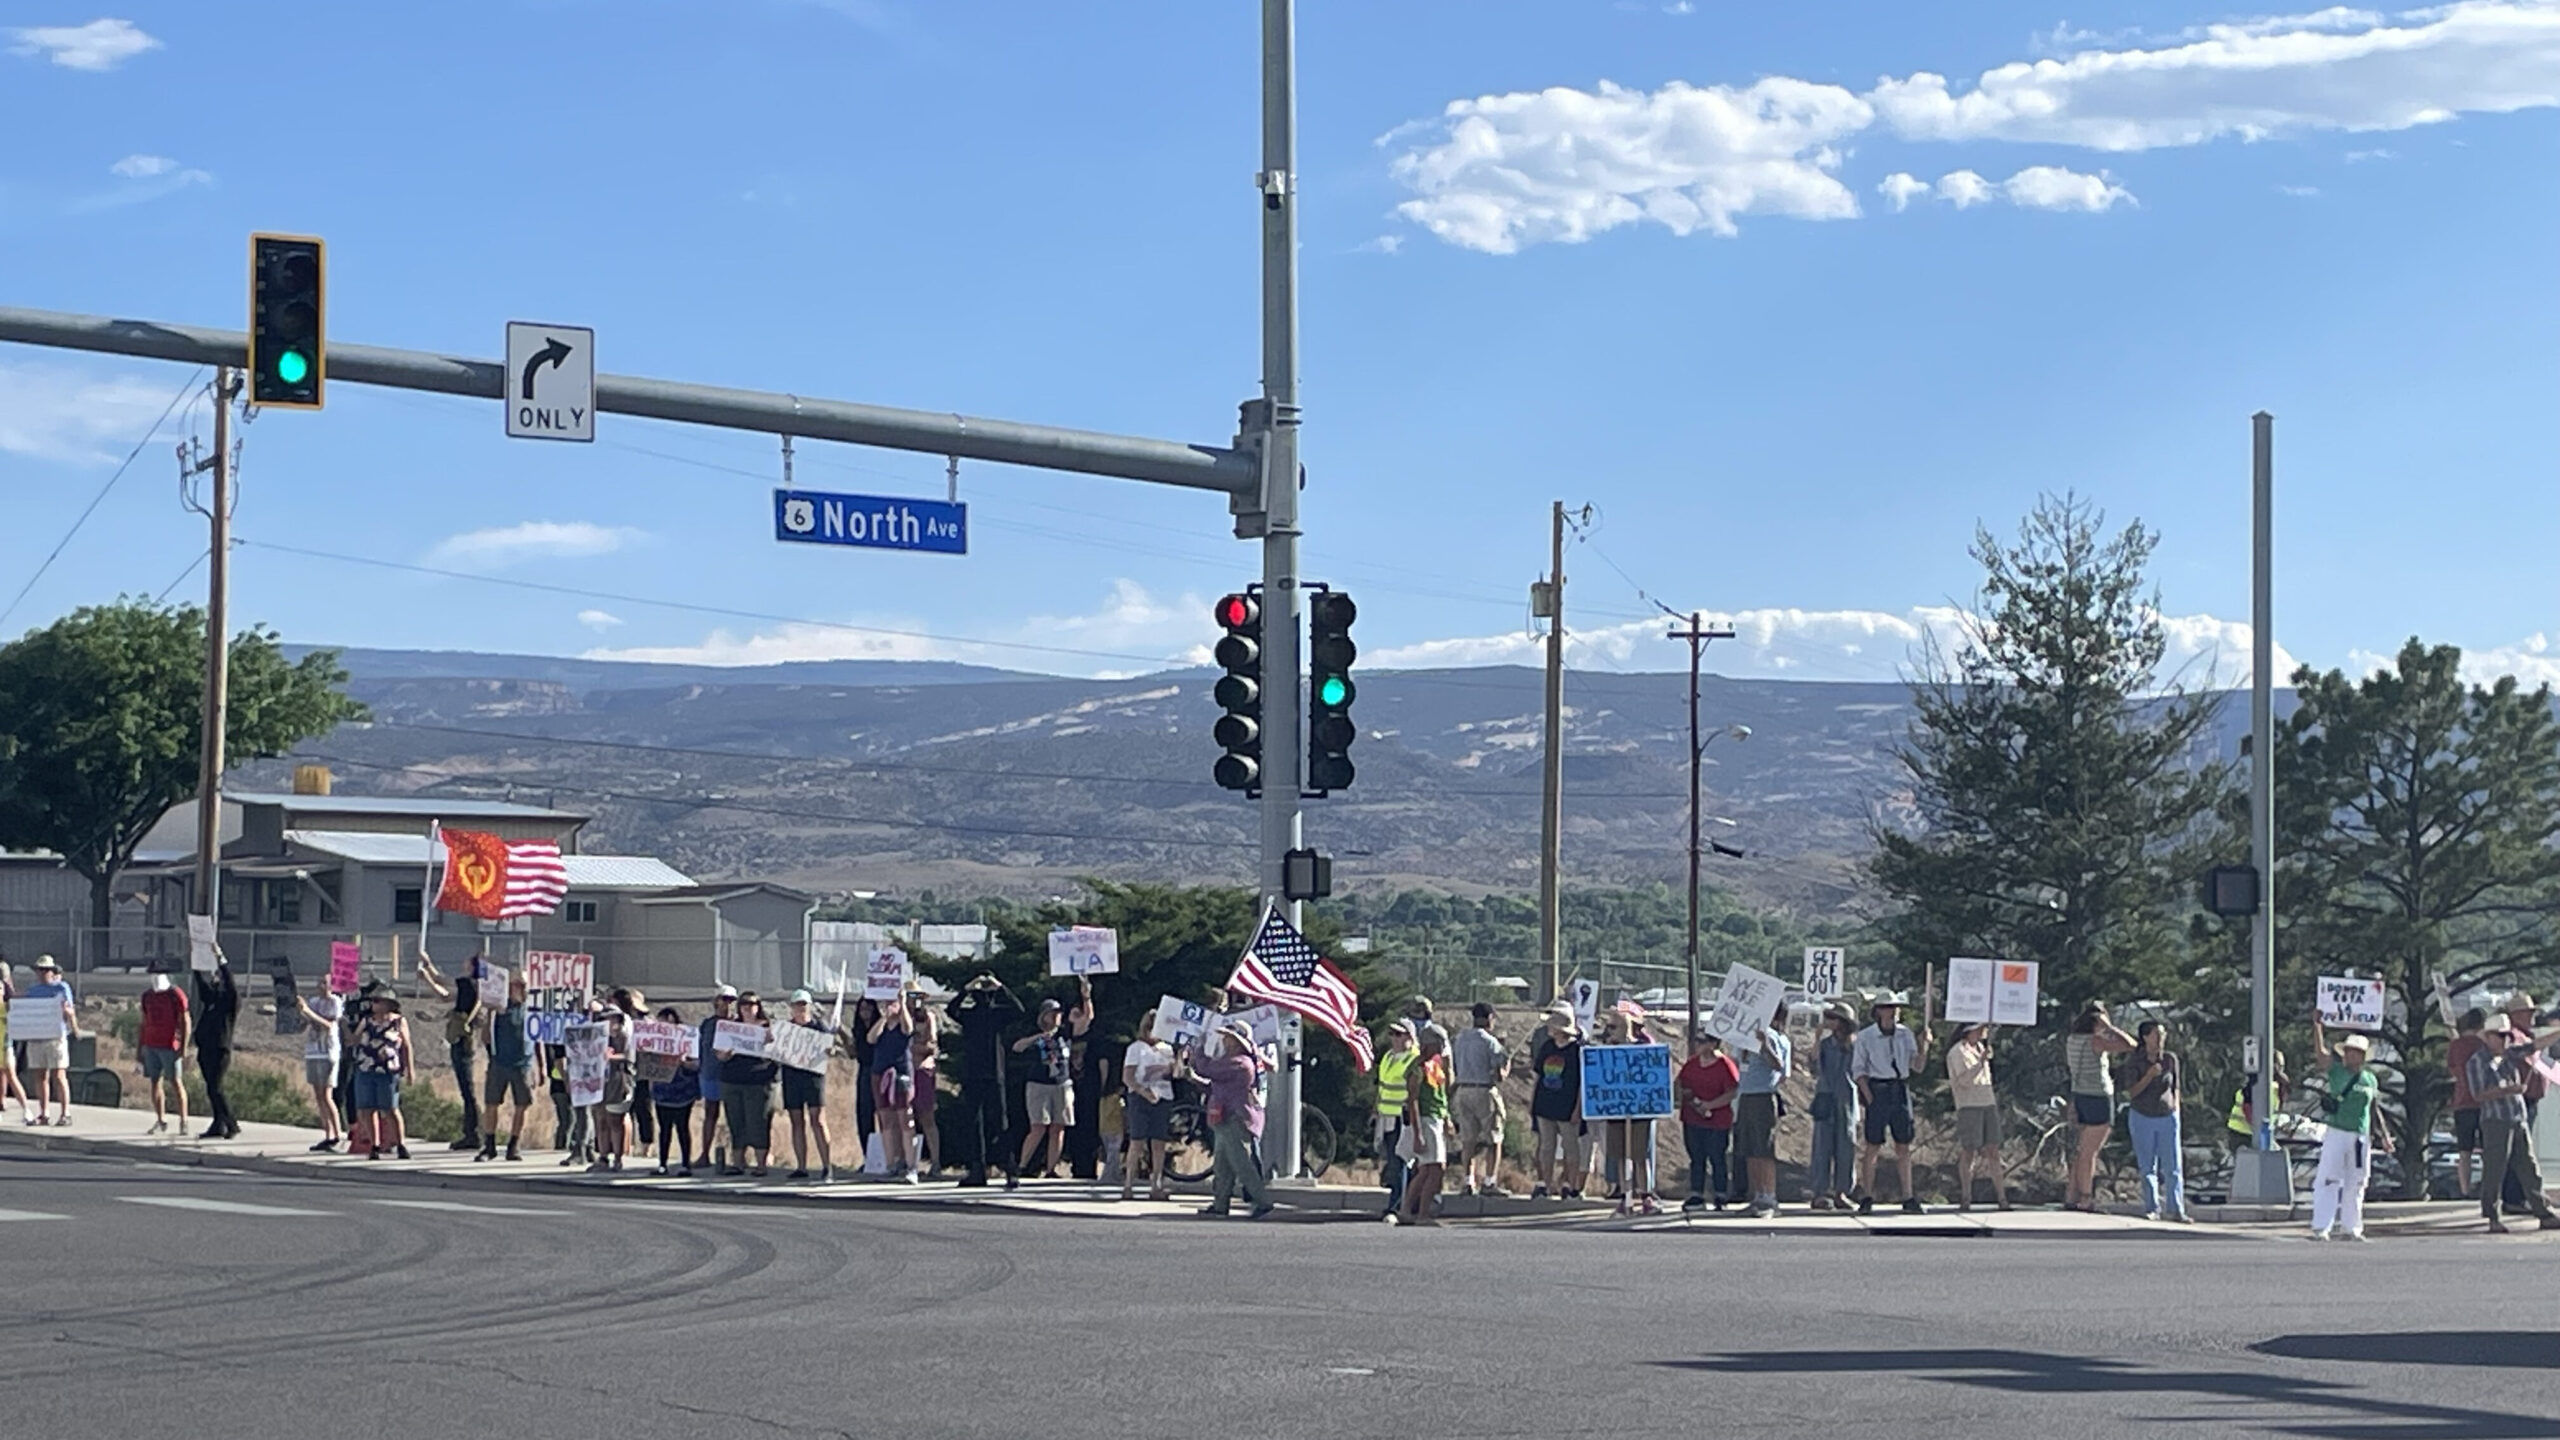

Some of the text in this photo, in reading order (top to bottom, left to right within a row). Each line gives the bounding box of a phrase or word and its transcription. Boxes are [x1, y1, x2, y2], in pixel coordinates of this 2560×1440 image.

[520, 407, 584, 430] ONLY
[794, 500, 958, 544] 6 North Ave
[1069, 952, 1105, 973] LA
[1813, 950, 1838, 963] GET
[529, 953, 591, 989] REJECT
[1811, 963, 1837, 979] ICE
[1735, 977, 1769, 997] WE
[1807, 978, 1837, 995] OUT
